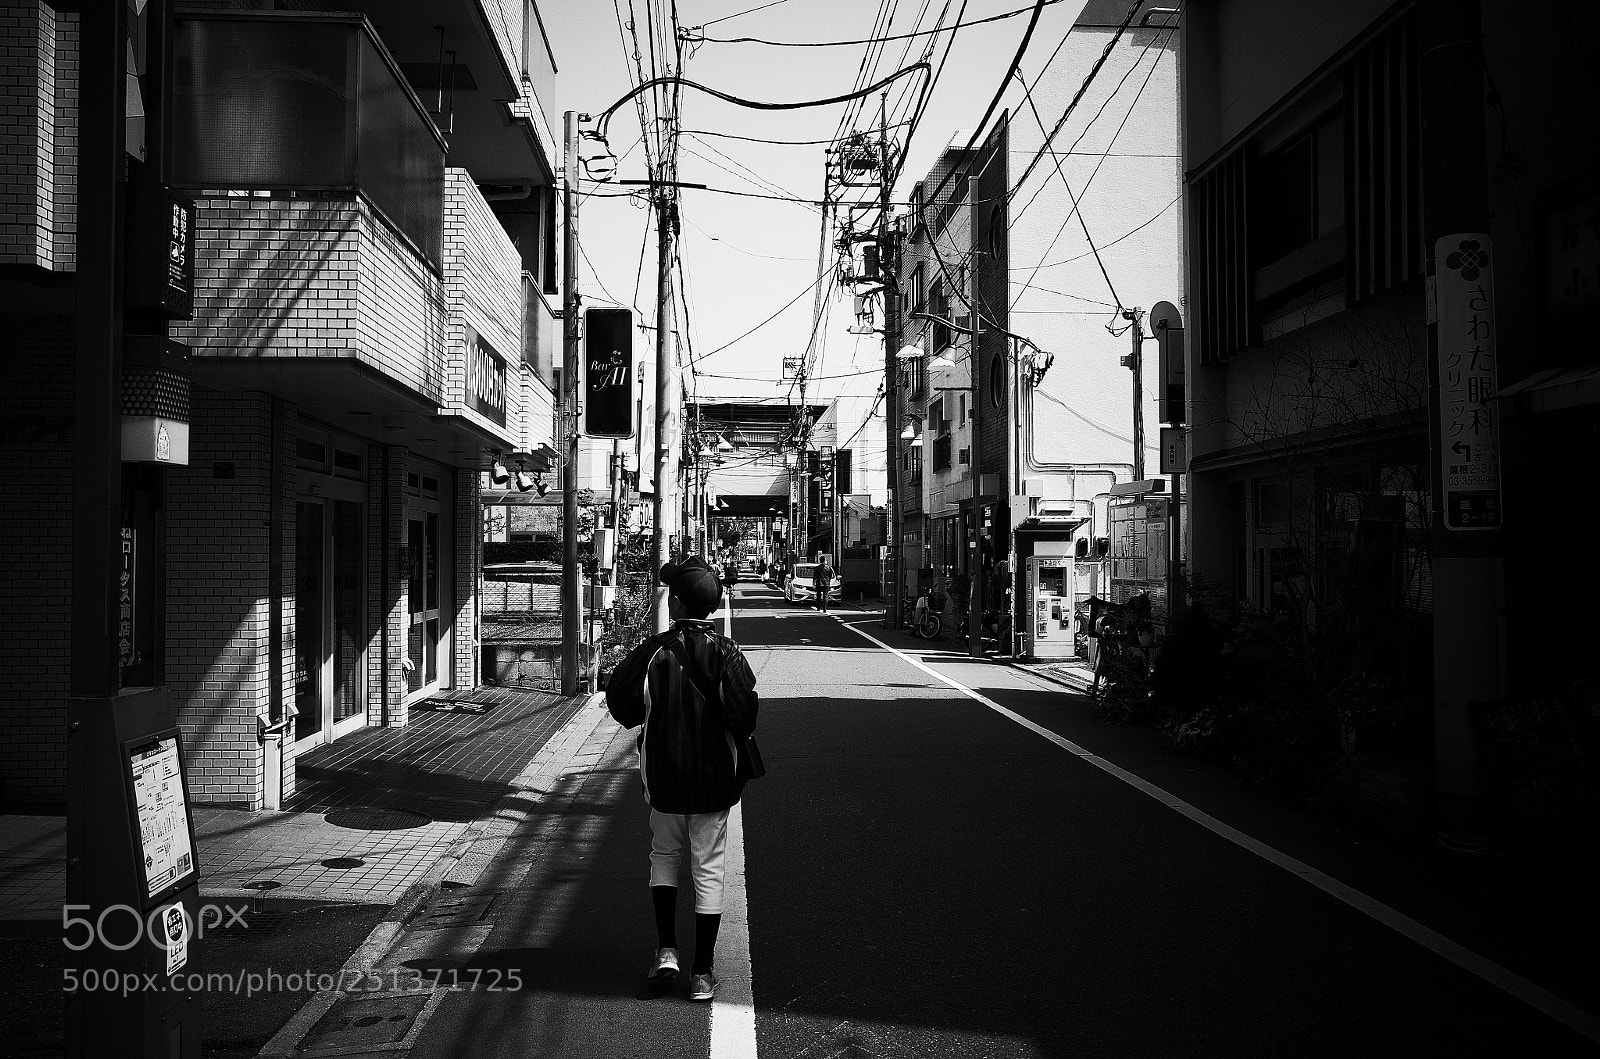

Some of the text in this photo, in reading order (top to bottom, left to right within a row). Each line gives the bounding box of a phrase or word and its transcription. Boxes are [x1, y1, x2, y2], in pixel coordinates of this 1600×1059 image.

[590, 359, 611, 371] Bar
[1466, 284, 1495, 437] さわだ眼科
[1446, 351, 1466, 438] クリニック
[170, 940, 184, 958] LED
